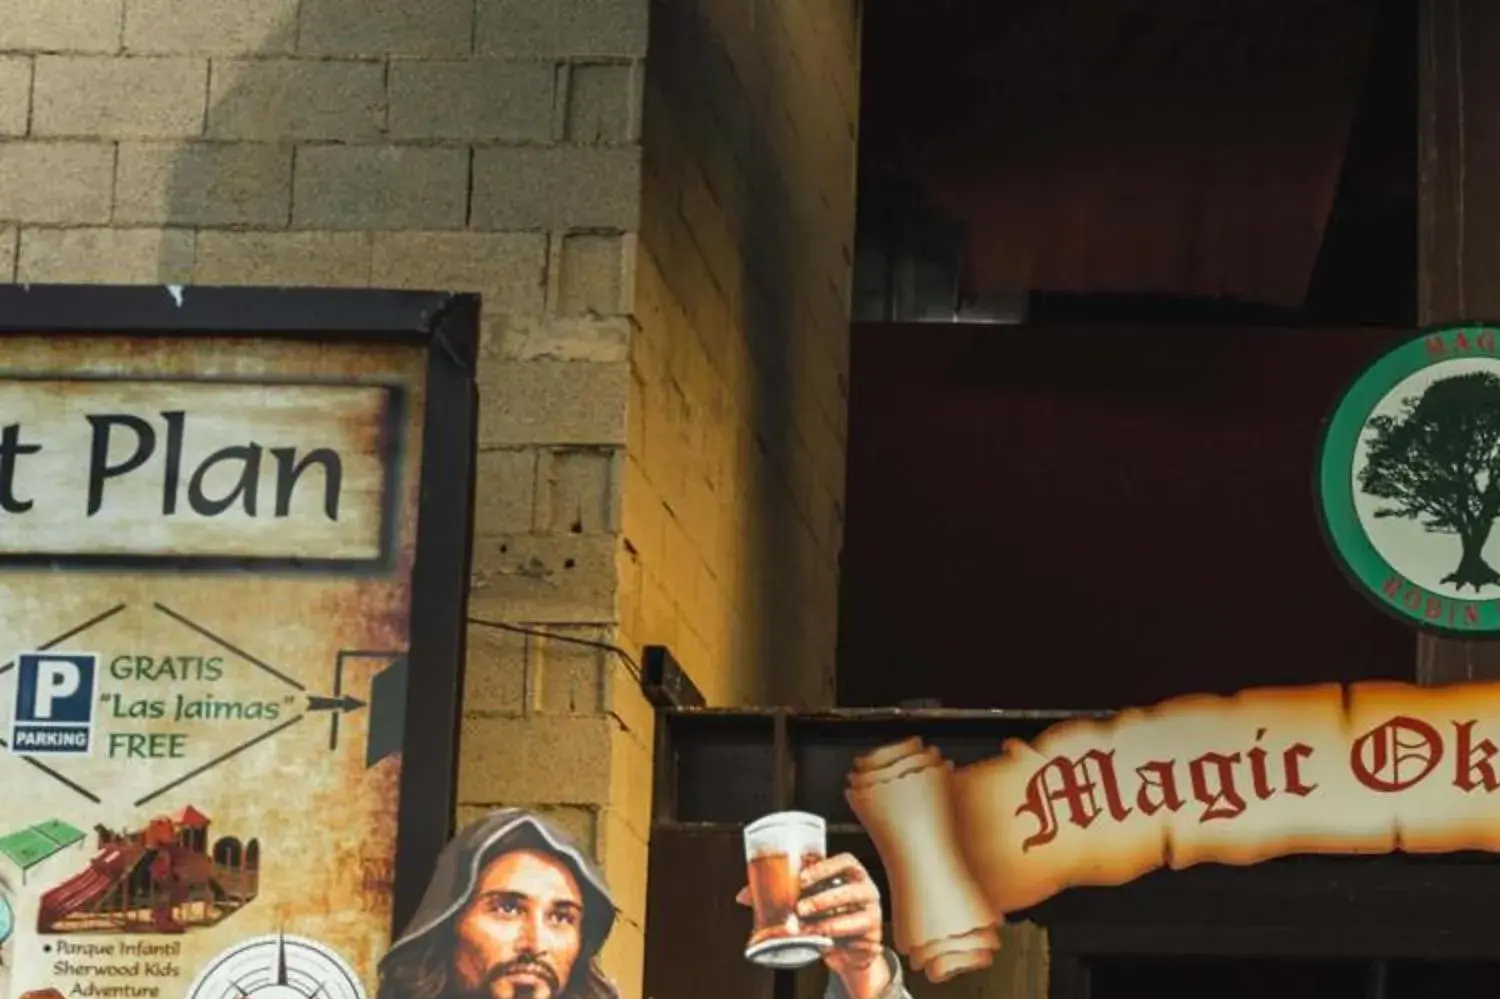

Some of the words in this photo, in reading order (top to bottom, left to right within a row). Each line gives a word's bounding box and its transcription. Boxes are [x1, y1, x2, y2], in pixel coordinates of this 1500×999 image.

[86, 410, 342, 521] Plan
[1383, 576, 1479, 626] ROBIN
[110, 655, 223, 681] GRATIS
[34, 660, 80, 718] P
[15, 731, 87, 746] PARKING
[108, 733, 188, 759] FREE
[1014, 729, 1320, 852] Magic
[57, 940, 114, 957] Parque
[120, 940, 182, 956] Infantil
[53, 960, 139, 976] Sherwood
[144, 962, 180, 977] Kids
[70, 981, 159, 998] Adventure
